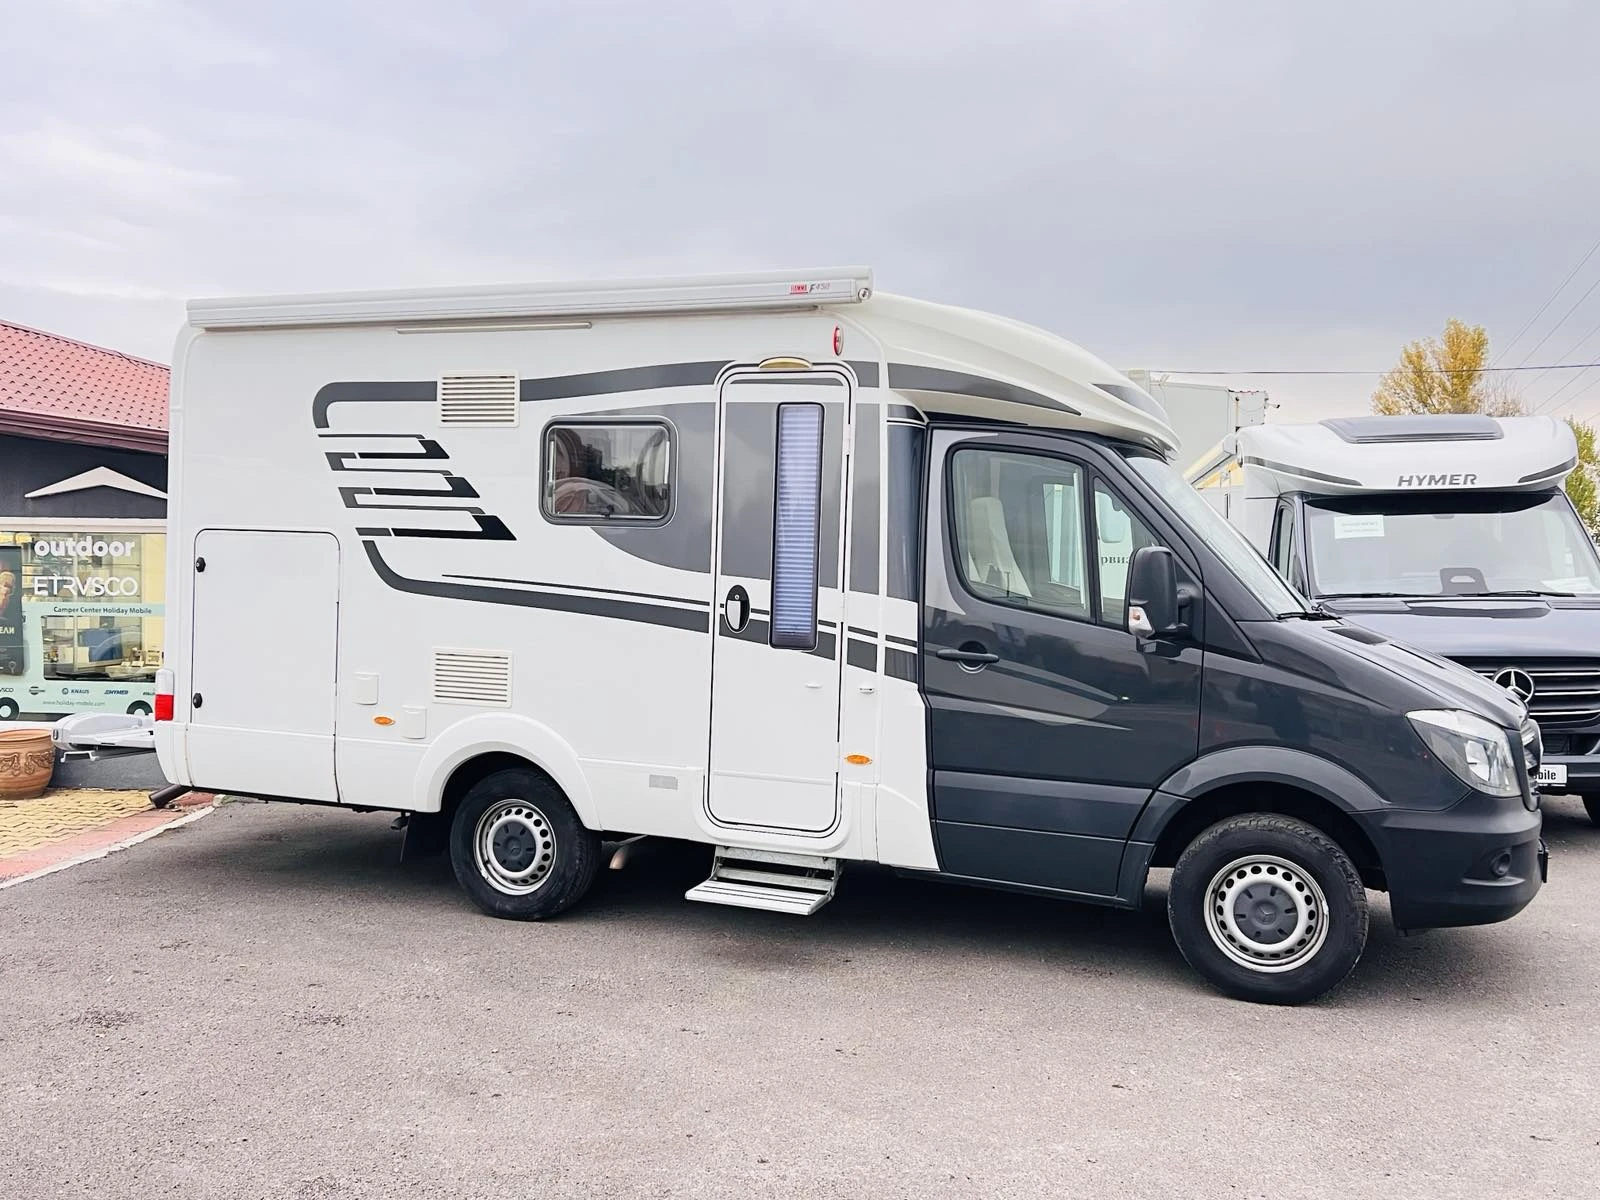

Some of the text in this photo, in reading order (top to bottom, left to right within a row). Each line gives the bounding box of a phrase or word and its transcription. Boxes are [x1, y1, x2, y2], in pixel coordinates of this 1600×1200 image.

[1397, 474, 1478, 487] HYMER
[34, 536, 135, 557] outdoor
[53, 606, 79, 614] Camper
[103, 607, 128, 615] Holiday
